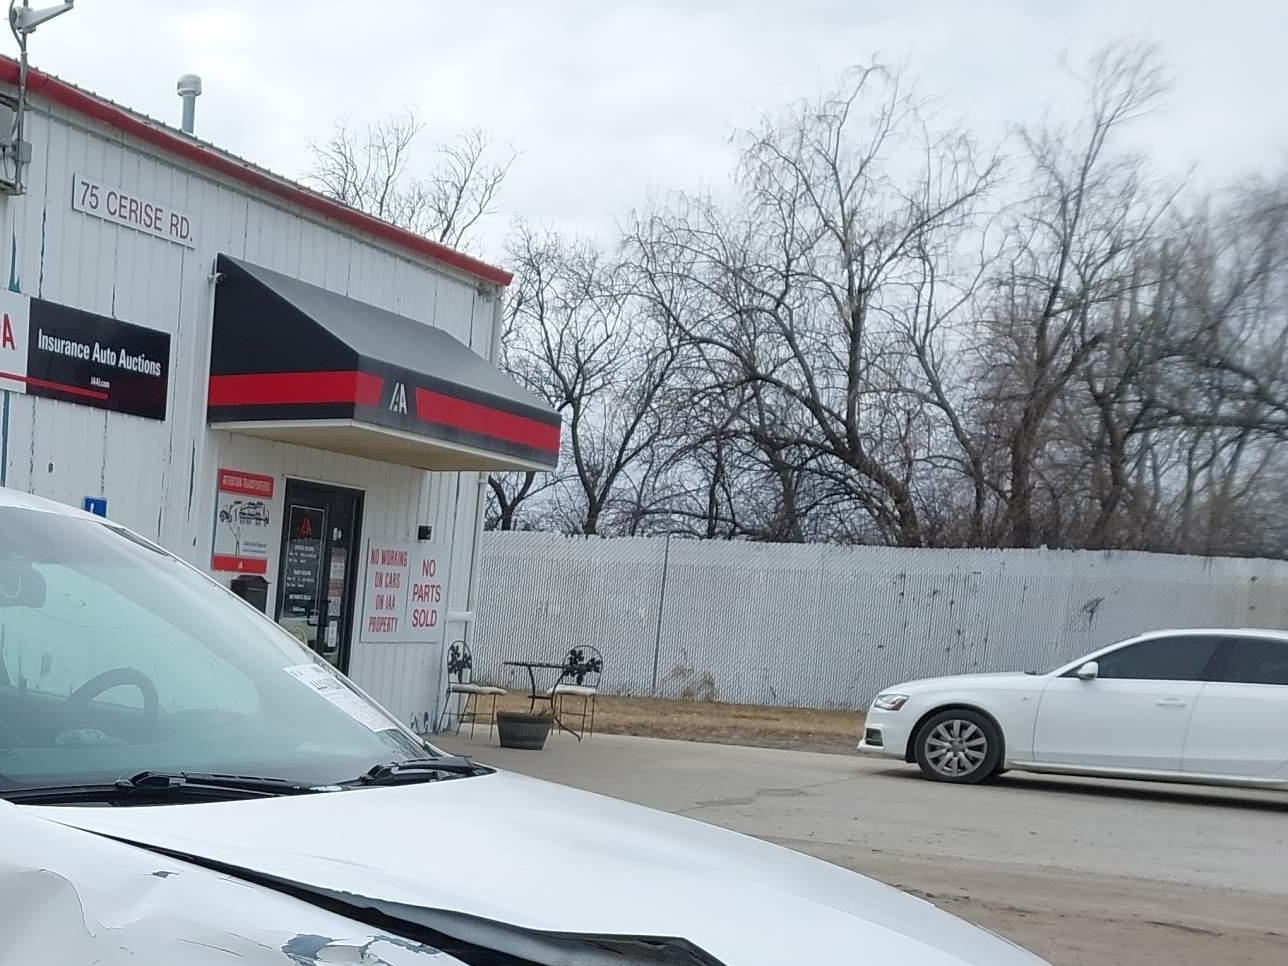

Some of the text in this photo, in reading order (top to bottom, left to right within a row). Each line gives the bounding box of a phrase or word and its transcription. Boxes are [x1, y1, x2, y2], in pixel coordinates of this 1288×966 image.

[81, 181, 193, 242] 75 CERISE RD.
[38, 328, 162, 377] Insurance Auto Auctions
[371, 548, 408, 567] NO WORKING
[422, 559, 436, 578] NO
[374, 571, 400, 589] ON CARS
[376, 593, 396, 610] ON IAA
[412, 584, 441, 602] PARTS
[368, 616, 398, 632] PROPERTY
[412, 608, 438, 628] SOLD
